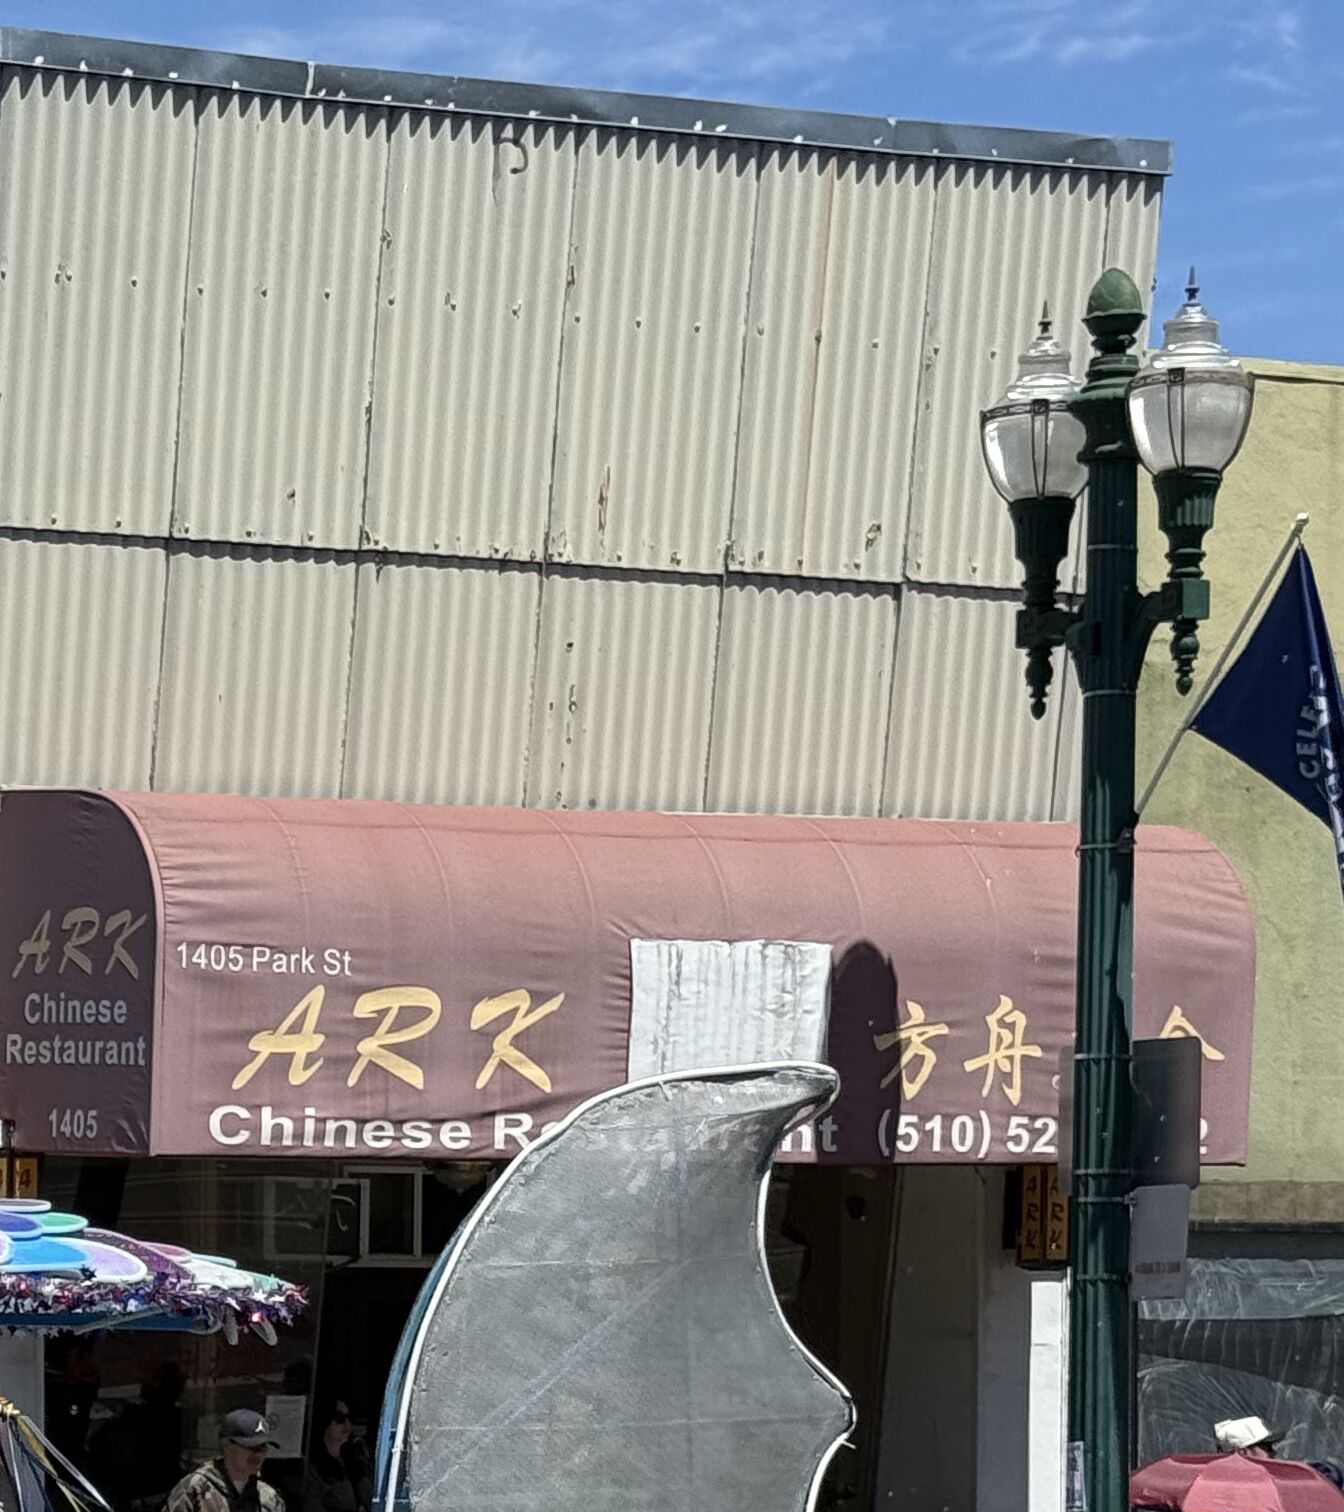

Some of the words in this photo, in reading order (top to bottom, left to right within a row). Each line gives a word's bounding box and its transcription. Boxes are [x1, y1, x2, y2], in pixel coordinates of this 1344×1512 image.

[11, 906, 148, 980] ARK
[176, 942, 244, 973] 1405
[252, 946, 315, 975] Park
[323, 949, 352, 976] St
[24, 992, 127, 1025] Chinese
[6, 1033, 146, 1066] Restaurant
[231, 984, 566, 1093] ARK
[48, 1108, 98, 1140] 1405
[208, 1105, 473, 1151] Chinese
[877, 1109, 992, 1159] (510)
